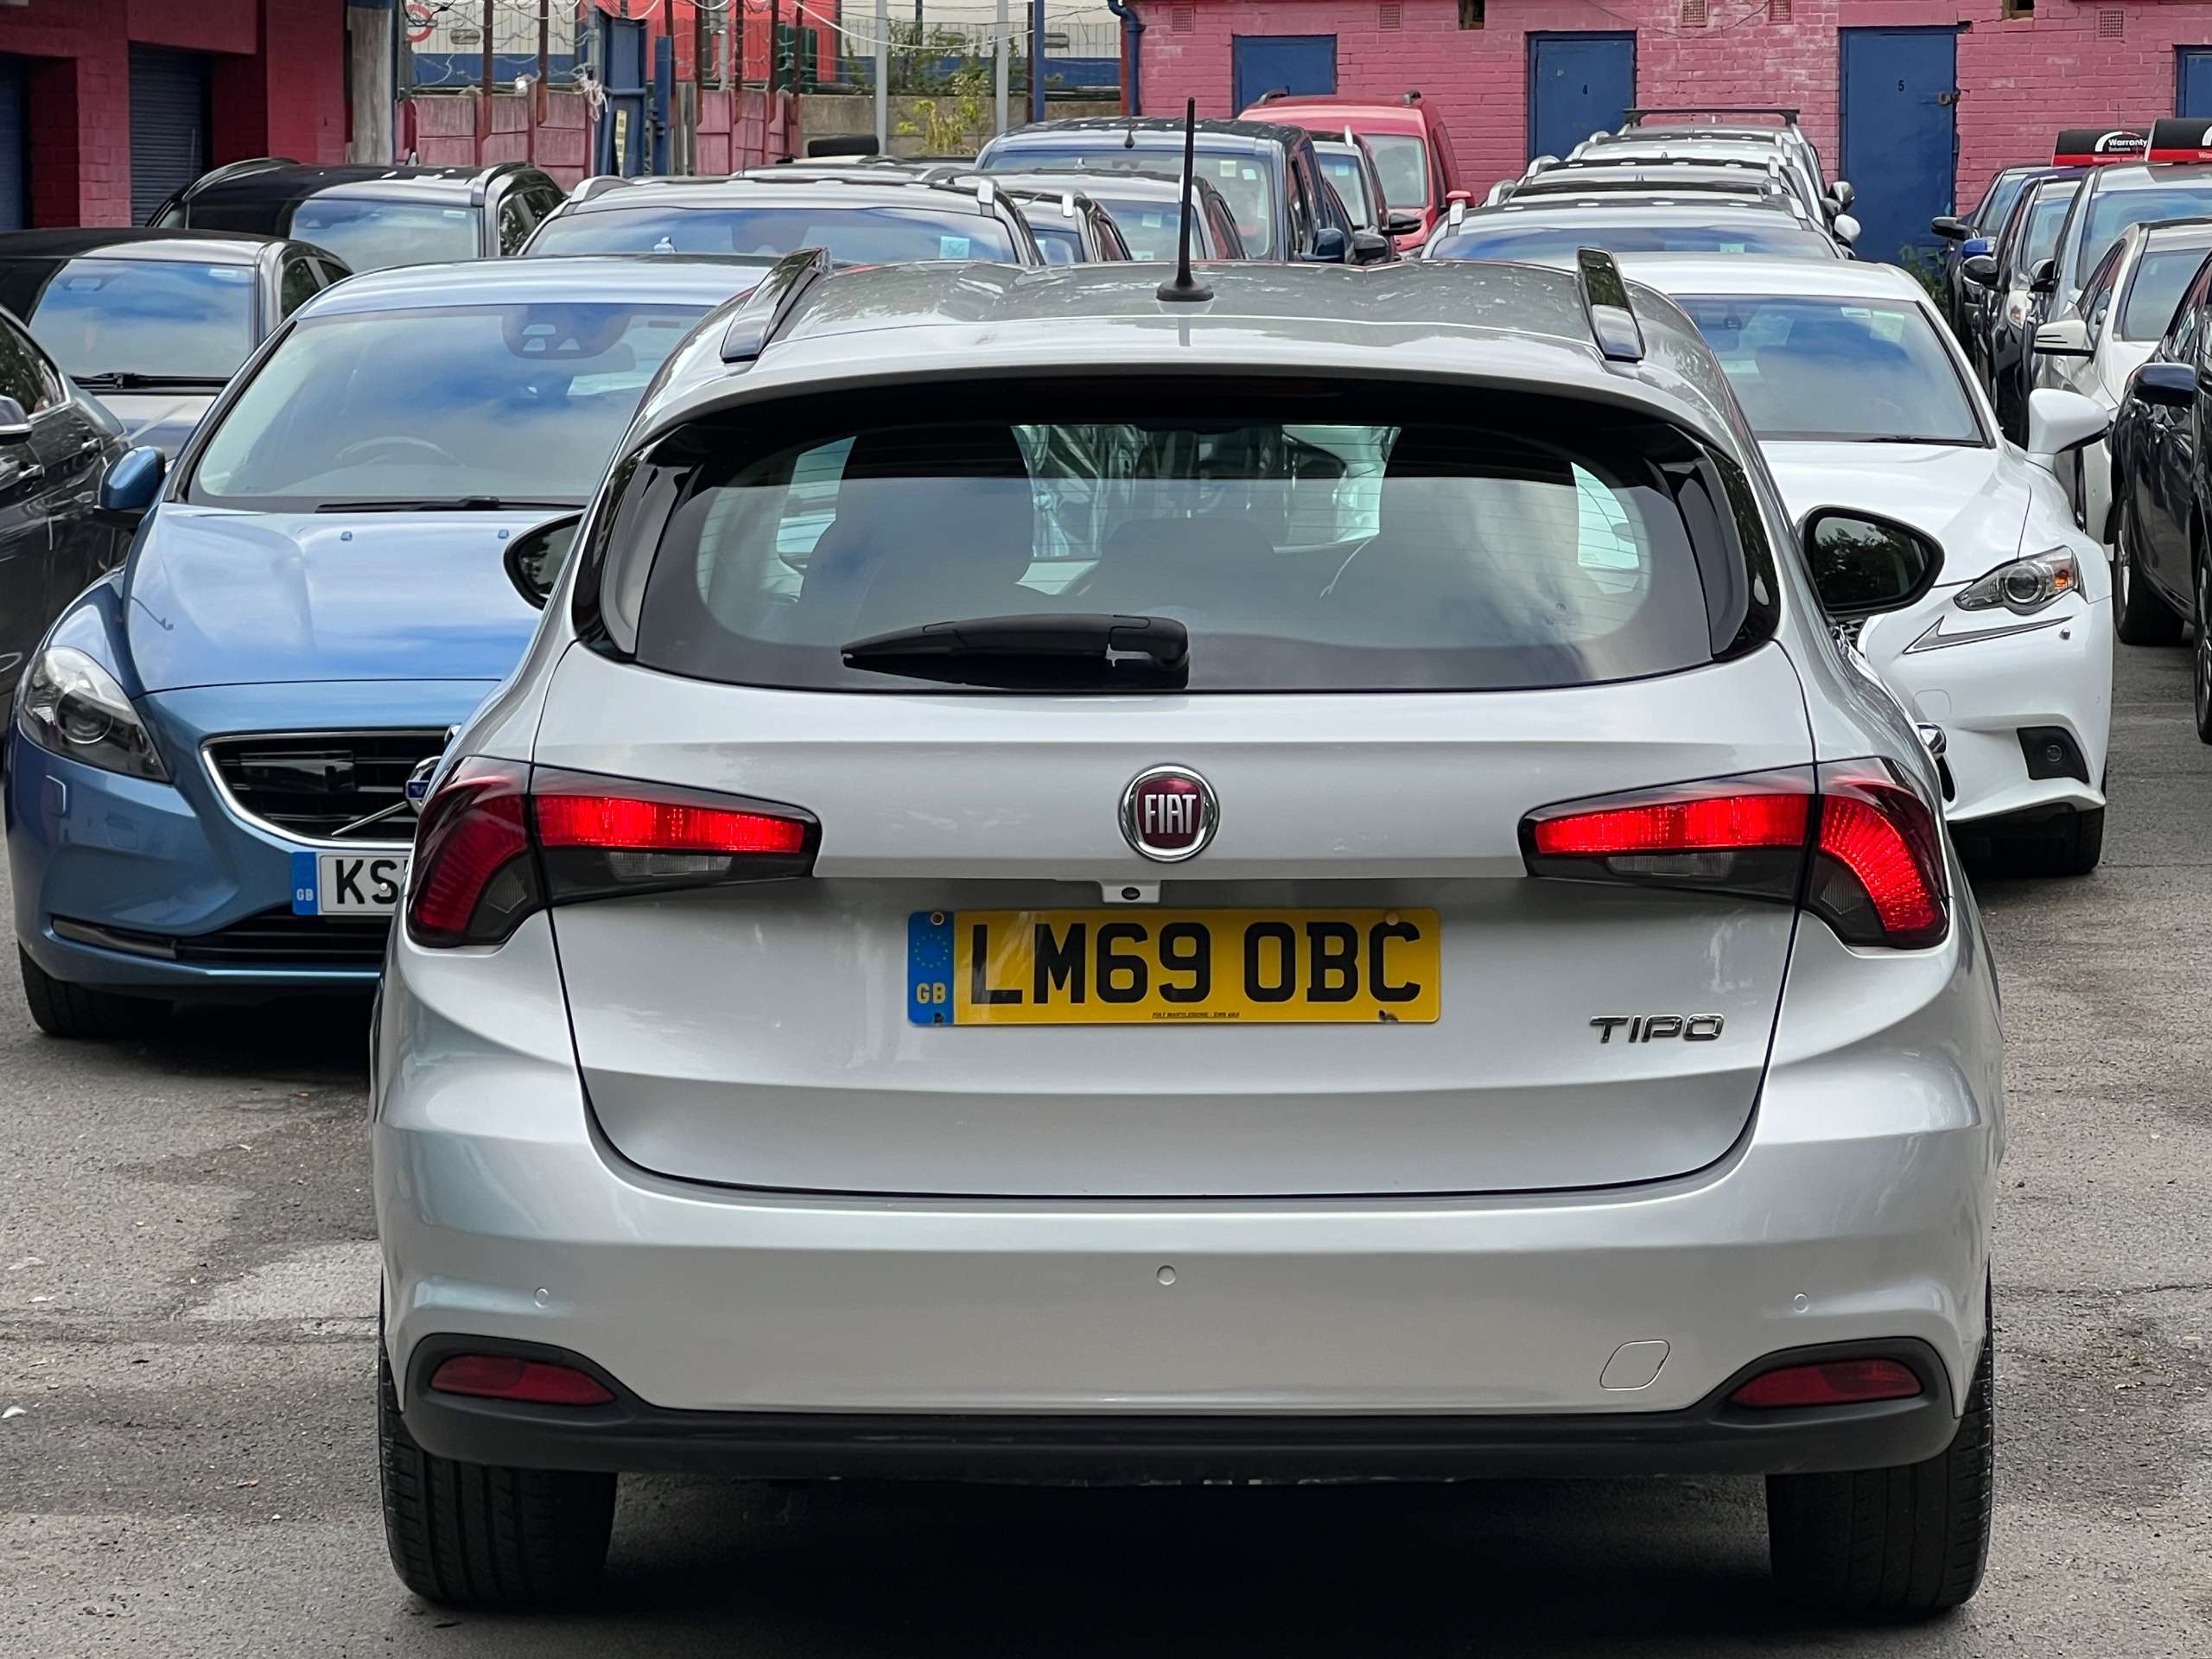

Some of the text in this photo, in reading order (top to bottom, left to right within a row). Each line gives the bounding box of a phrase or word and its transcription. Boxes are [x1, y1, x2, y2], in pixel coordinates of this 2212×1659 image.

[1582, 84, 1588, 95] 4
[1897, 79, 1904, 92] 5
[2108, 138, 2148, 148] Warranty
[1145, 794, 1197, 835] FIAT
[335, 859, 409, 905] KS
[296, 888, 314, 901] GB
[971, 922, 1211, 1005] LM69
[916, 982, 946, 1005] GB
[1590, 1013, 1725, 1044] TIPO
